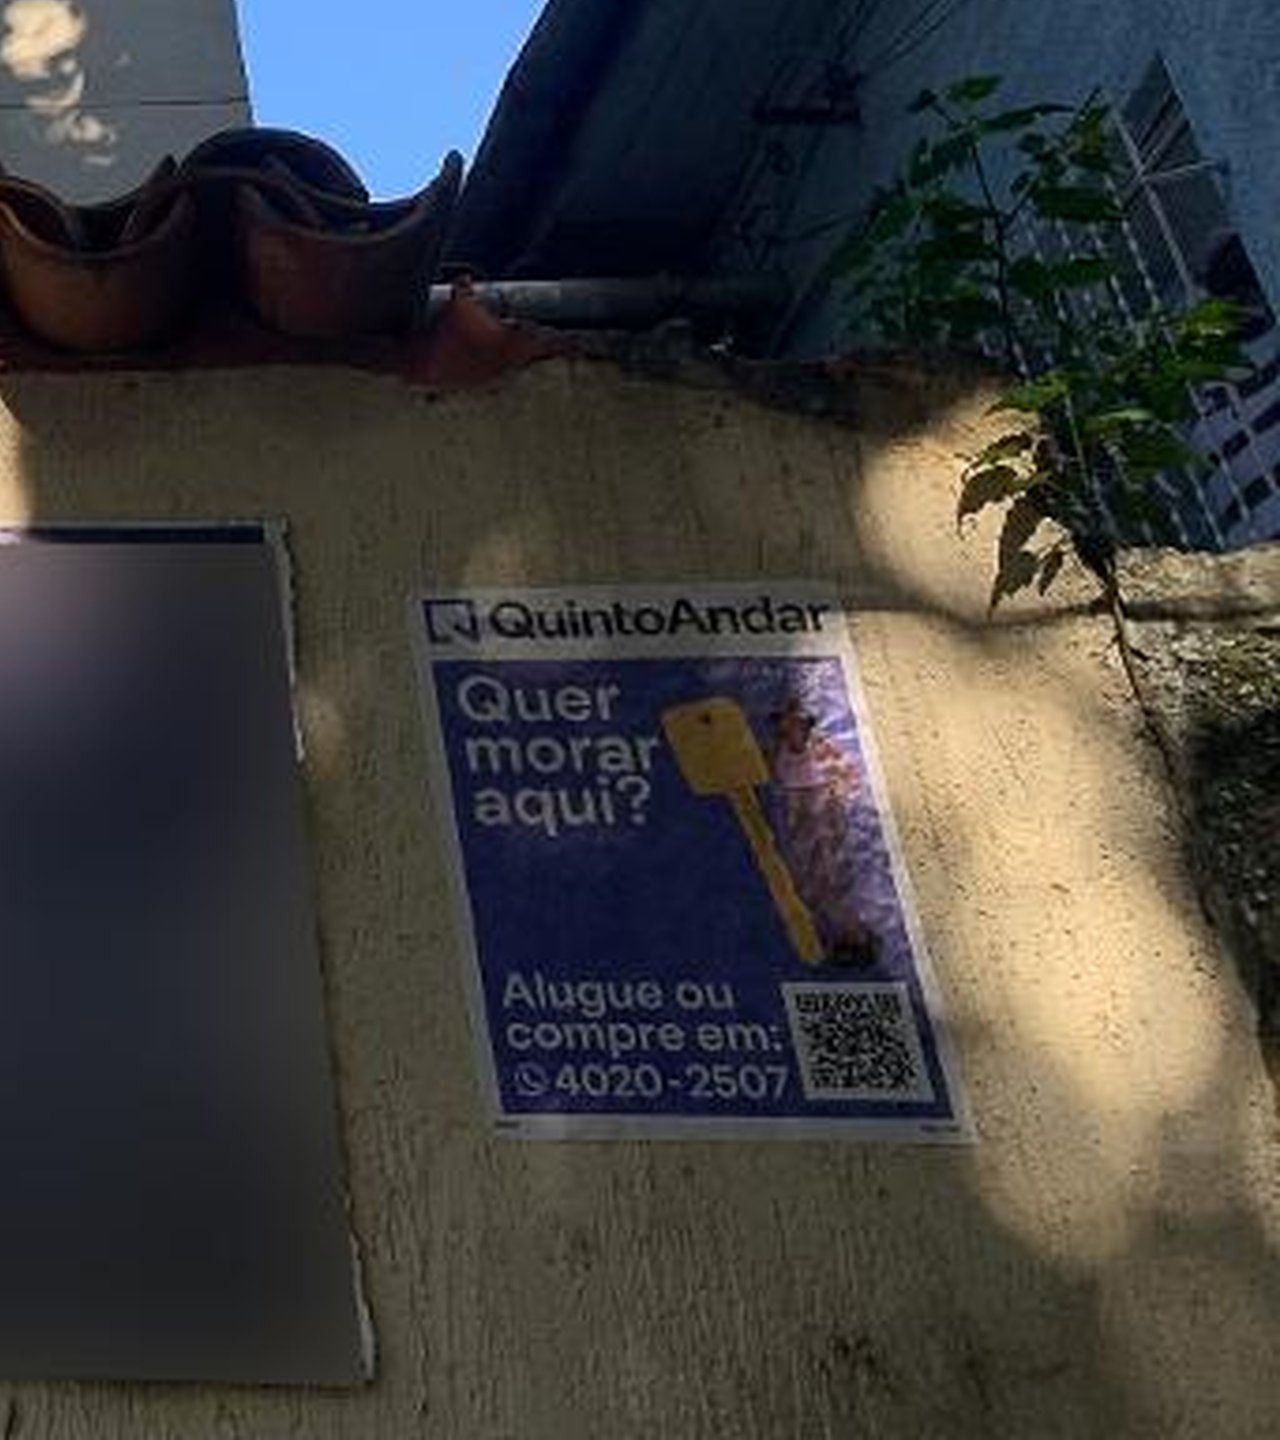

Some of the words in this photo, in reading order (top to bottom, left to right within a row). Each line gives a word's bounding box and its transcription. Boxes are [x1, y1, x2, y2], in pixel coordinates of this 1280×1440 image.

[489, 596, 831, 640] QuintoAndar
[457, 674, 621, 723] Quer
[465, 733, 660, 774] morar
[473, 775, 651, 837] aqui?
[502, 971, 663, 1017] Alugue
[676, 982, 735, 1010] ou
[506, 1022, 685, 1058] compre
[697, 1024, 783, 1051] em:
